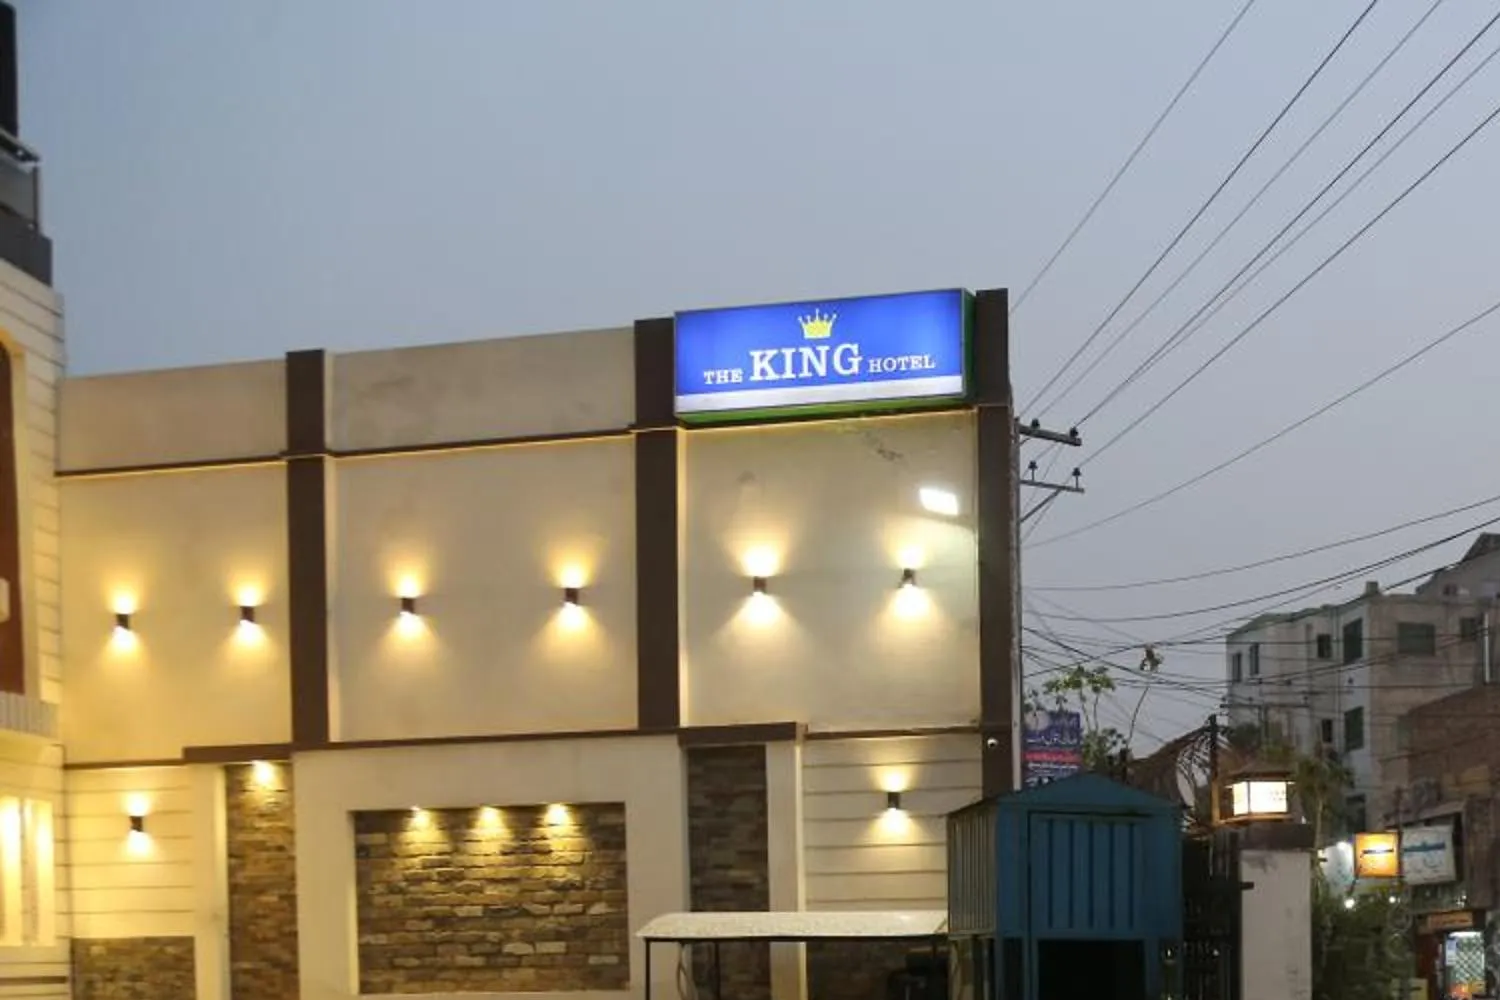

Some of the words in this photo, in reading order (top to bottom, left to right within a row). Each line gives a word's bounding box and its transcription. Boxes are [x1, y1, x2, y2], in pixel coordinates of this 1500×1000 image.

[704, 367, 742, 385] THE
[750, 343, 862, 381] KING
[869, 354, 935, 373] HOTEL
